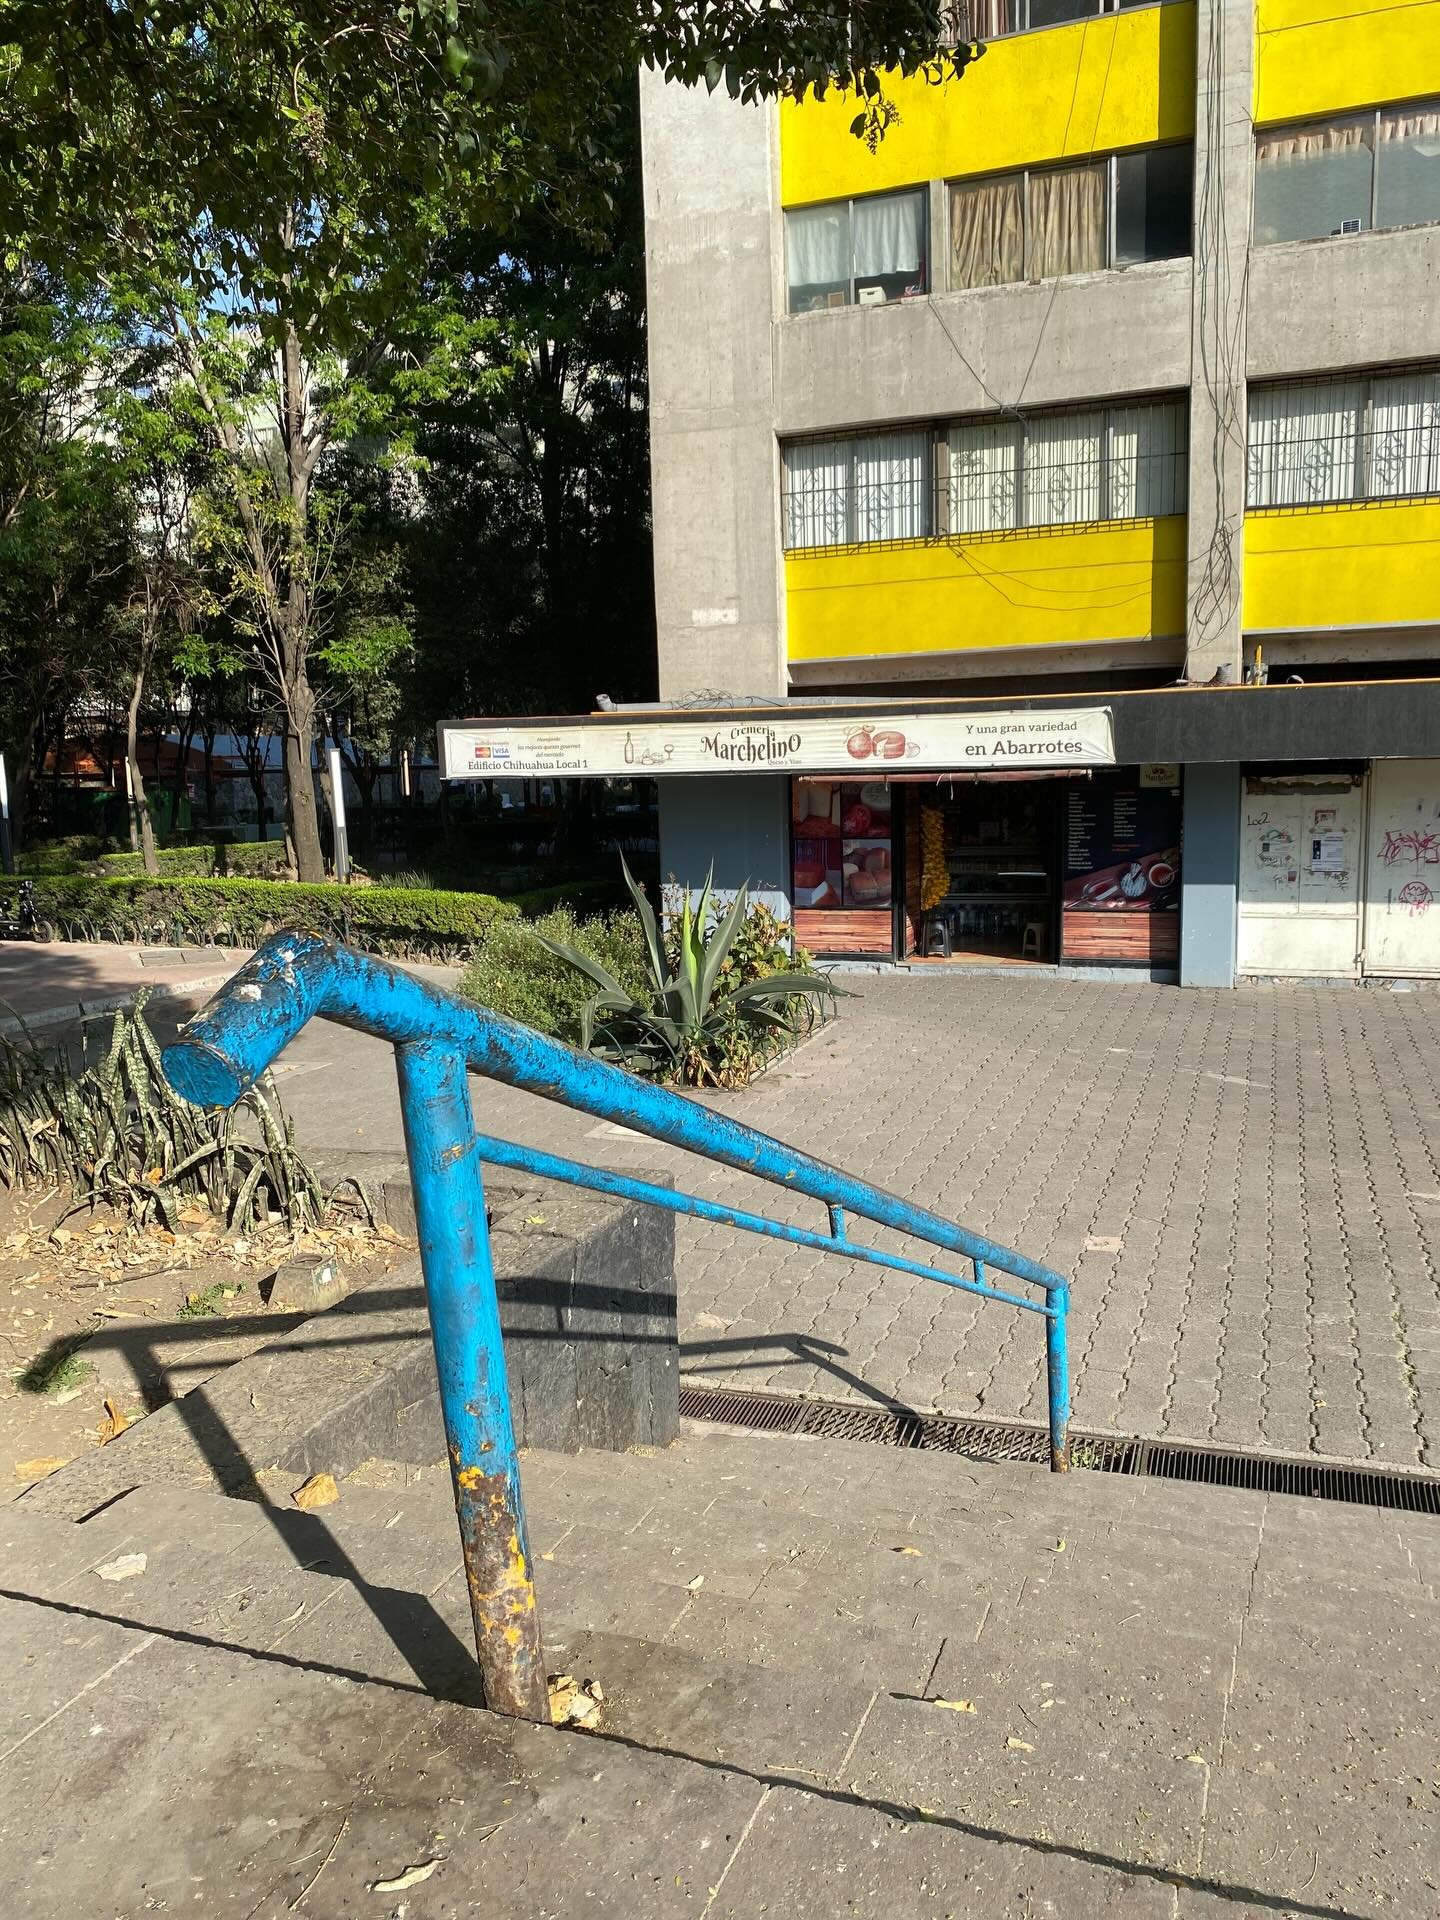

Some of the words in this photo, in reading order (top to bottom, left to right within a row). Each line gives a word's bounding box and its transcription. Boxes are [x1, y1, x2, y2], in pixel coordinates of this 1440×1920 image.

[965, 725, 974, 734] Y
[976, 725, 998, 734] una
[1000, 724, 1025, 735] gran
[1028, 721, 1078, 733] variedad
[965, 744, 987, 756] en
[992, 740, 1083, 756] Abarrotes
[468, 760, 502, 771] Edificio
[503, 760, 554, 770] Chihuahua
[556, 759, 581, 769] Local
[582, 759, 589, 769] 1
